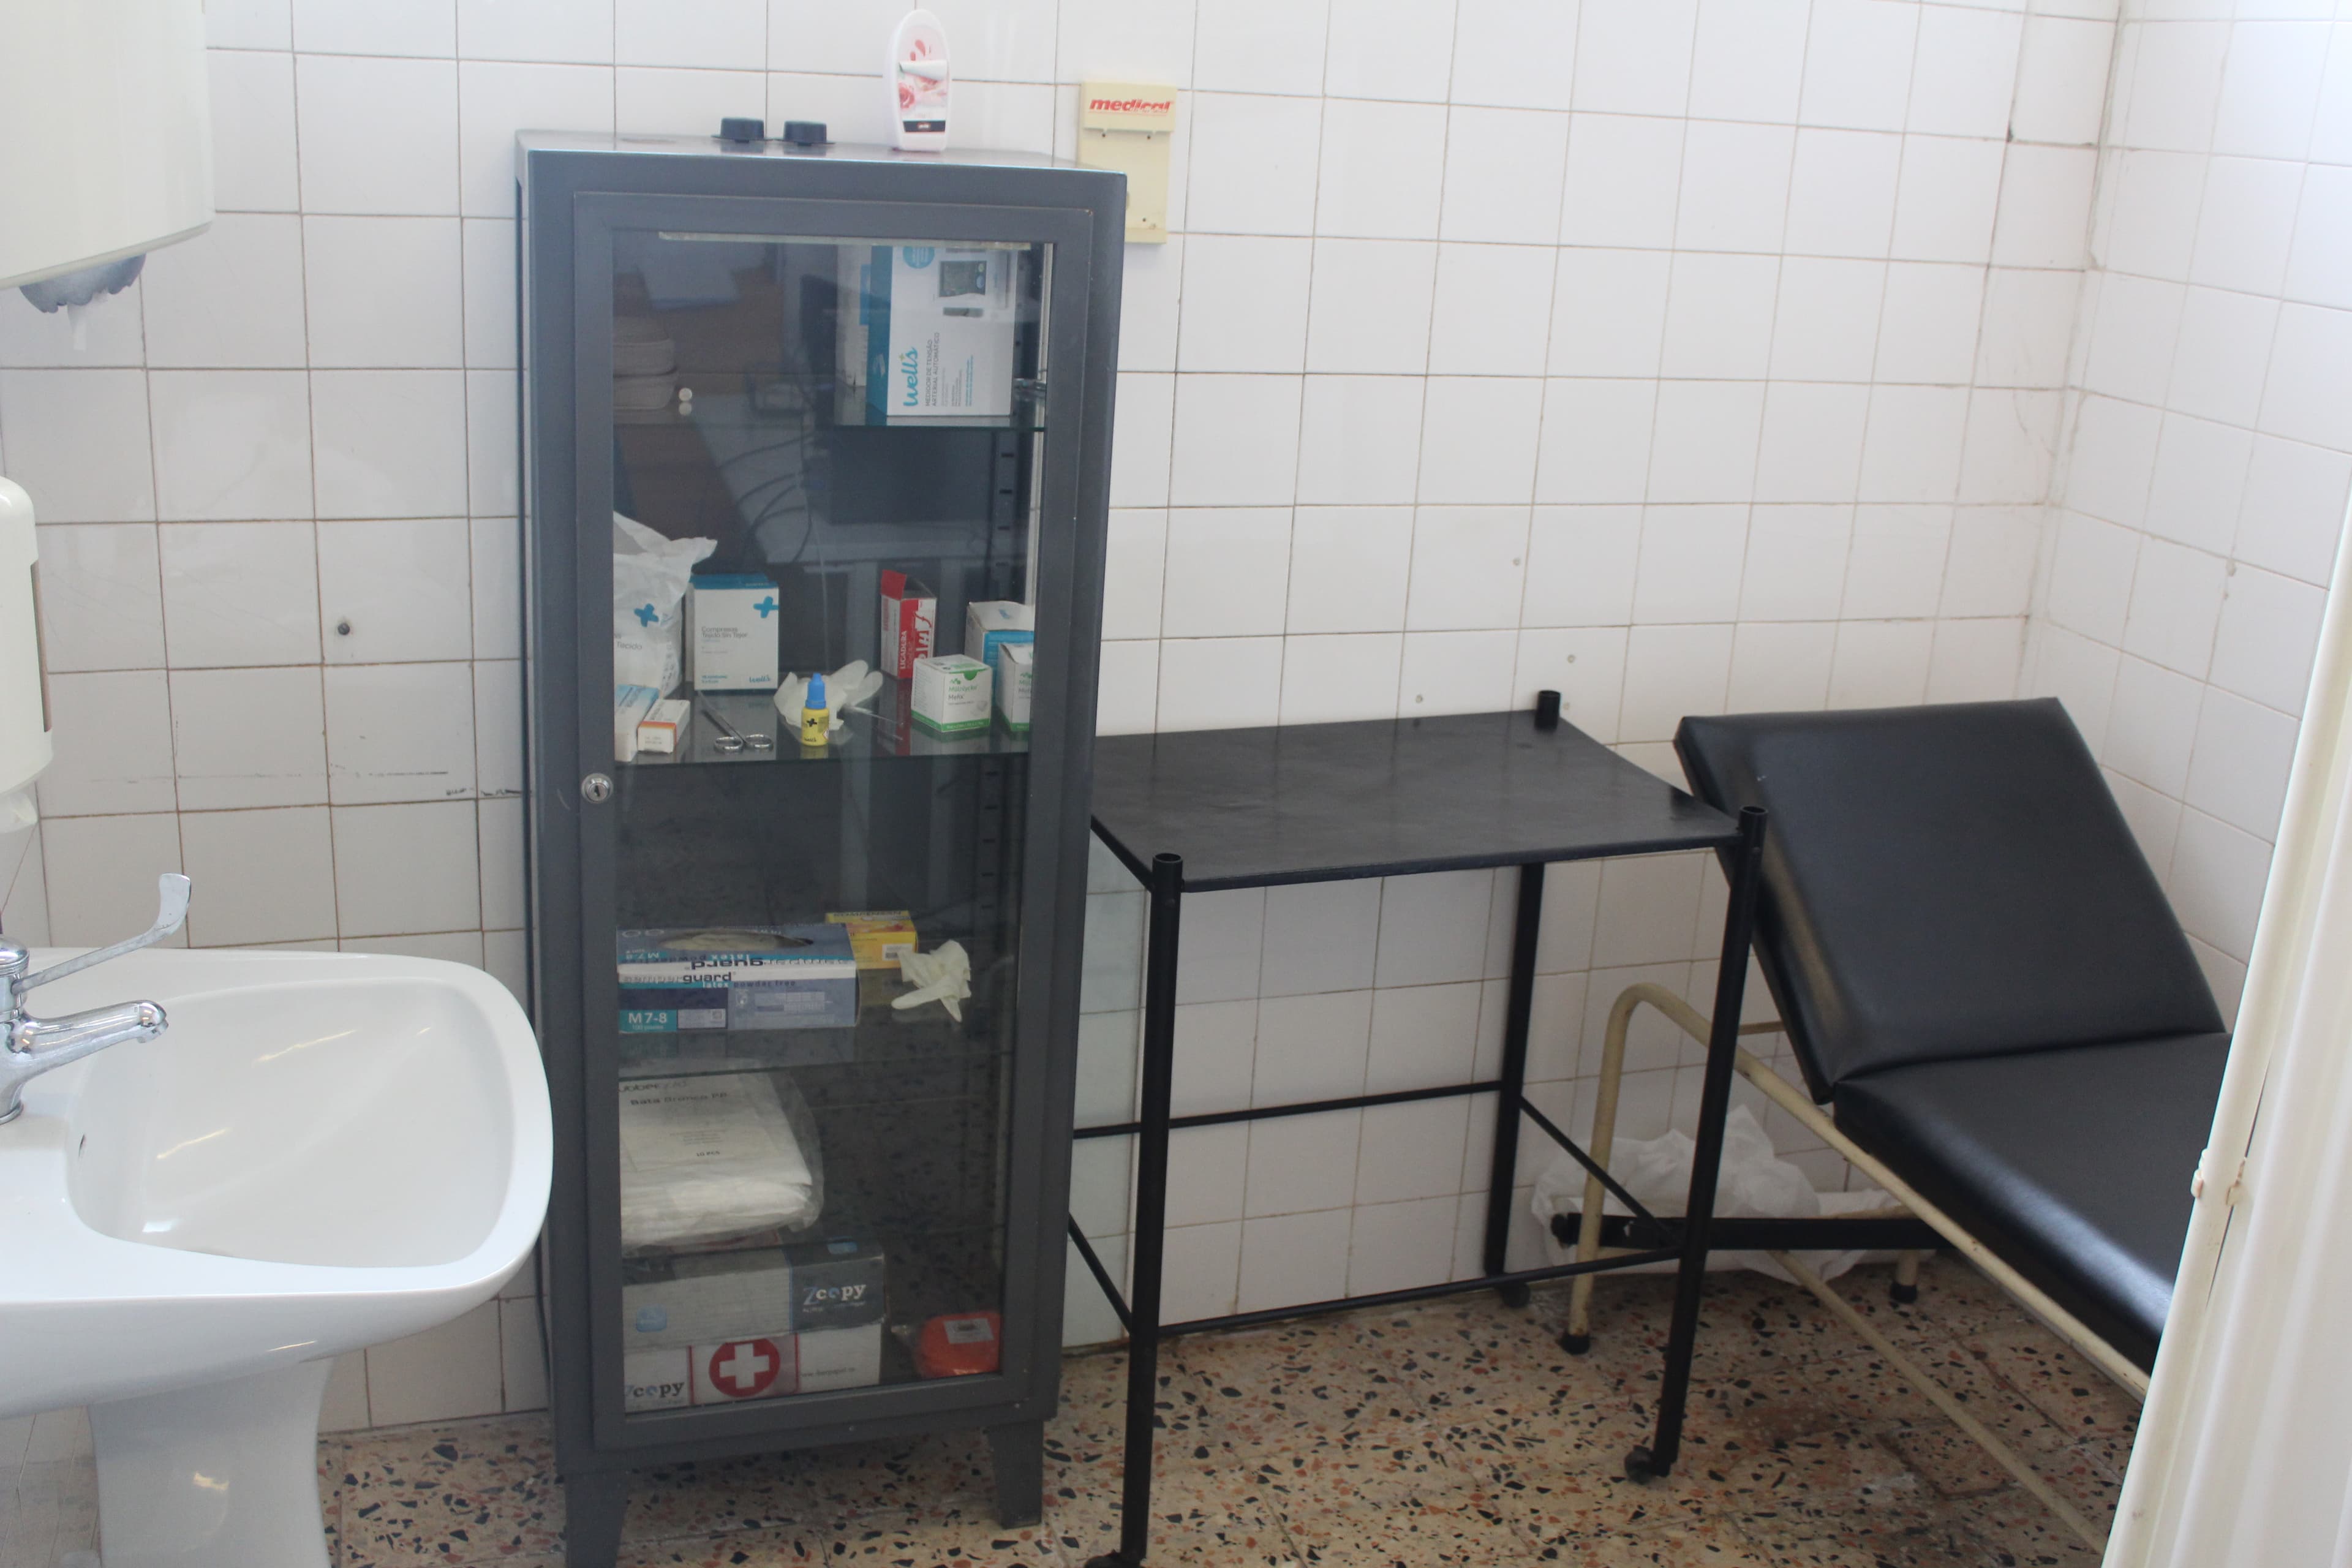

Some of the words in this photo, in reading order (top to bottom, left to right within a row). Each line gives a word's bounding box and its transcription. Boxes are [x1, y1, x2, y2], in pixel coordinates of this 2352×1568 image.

[901, 347, 918, 407] wells
[925, 367, 932, 376] DE
[628, 1012, 641, 1023] M
[644, 1012, 667, 1023] 7-8
